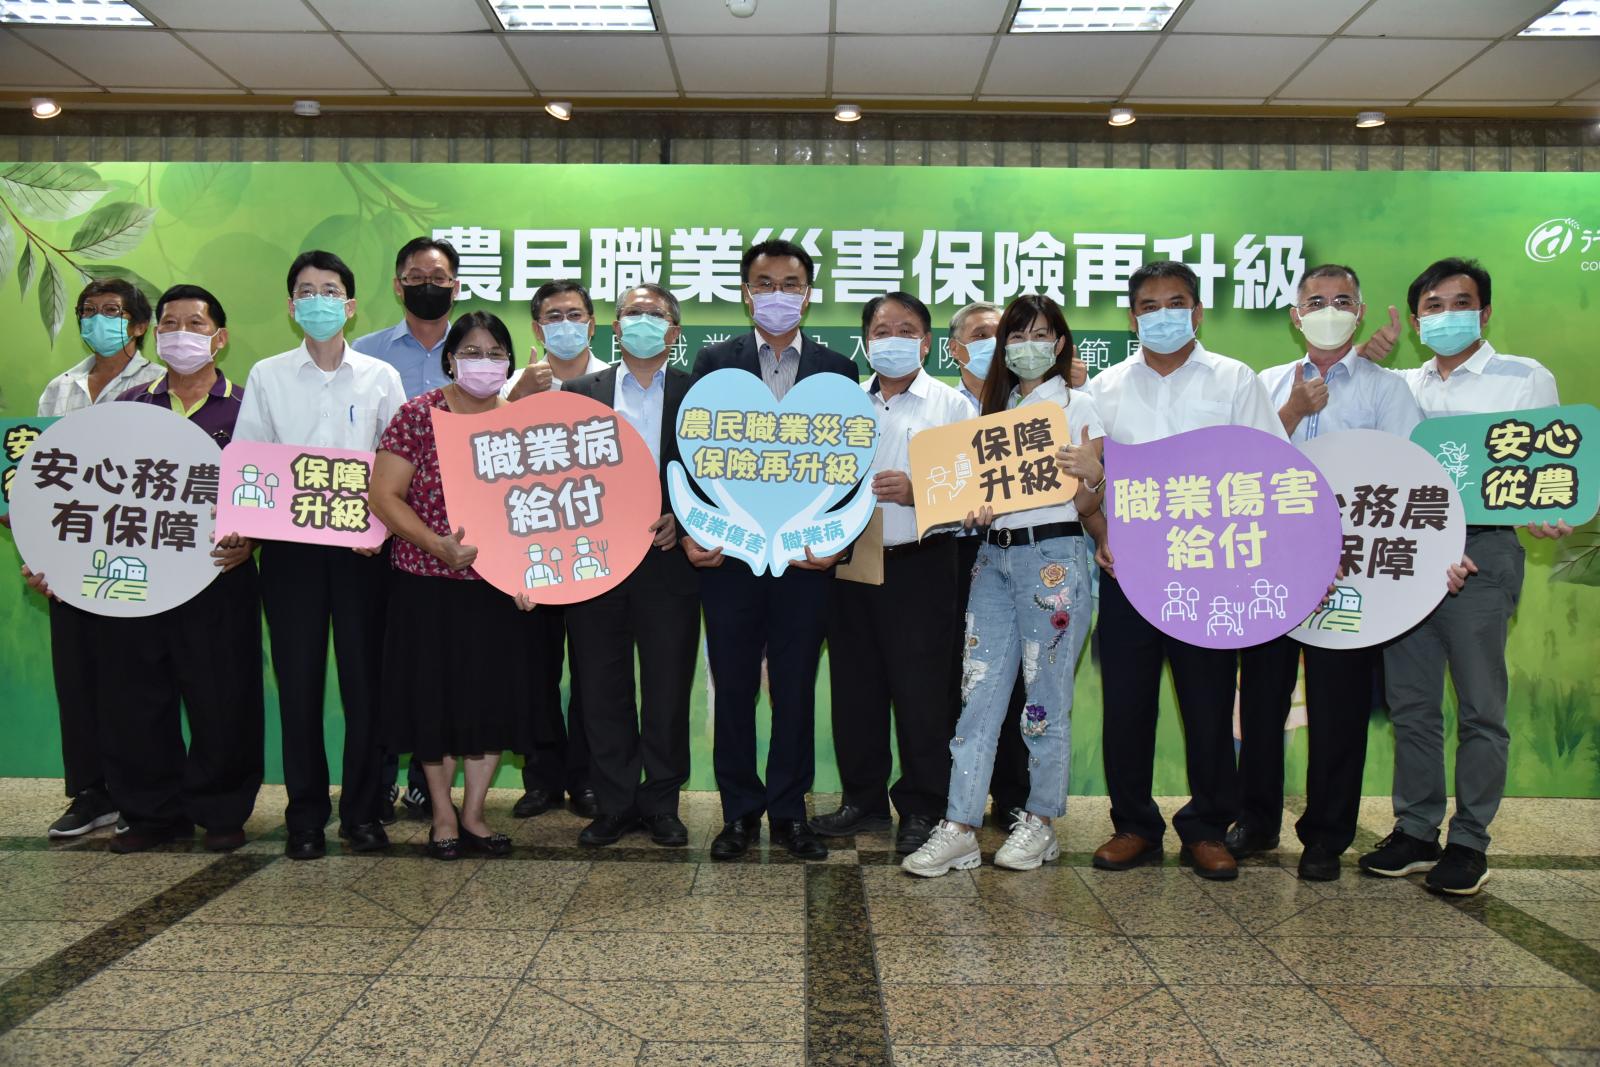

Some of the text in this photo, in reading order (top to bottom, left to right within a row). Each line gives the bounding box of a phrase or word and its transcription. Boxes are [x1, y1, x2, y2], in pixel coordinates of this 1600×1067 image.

[1581, 261, 1600, 271] CO
[471, 415, 623, 482] 職業病
[678, 407, 876, 448] 農民職業災害
[971, 417, 1055, 465] 保障
[1485, 418, 1580, 462] 安心
[31, 448, 220, 504] 安心務農
[292, 453, 370, 494] 保障
[692, 446, 862, 485] 保險再升級
[979, 455, 1062, 503] 升級
[1480, 462, 1578, 512] 從農
[291, 493, 370, 533] 升級
[505, 476, 607, 535] 給付
[1112, 467, 1319, 524] 職業傷害
[1335, 484, 1450, 531] 務農
[52, 500, 198, 552] 有保障
[685, 506, 768, 555] 職業傷害
[780, 519, 846, 552] 職業病
[1166, 522, 1268, 572] 給付
